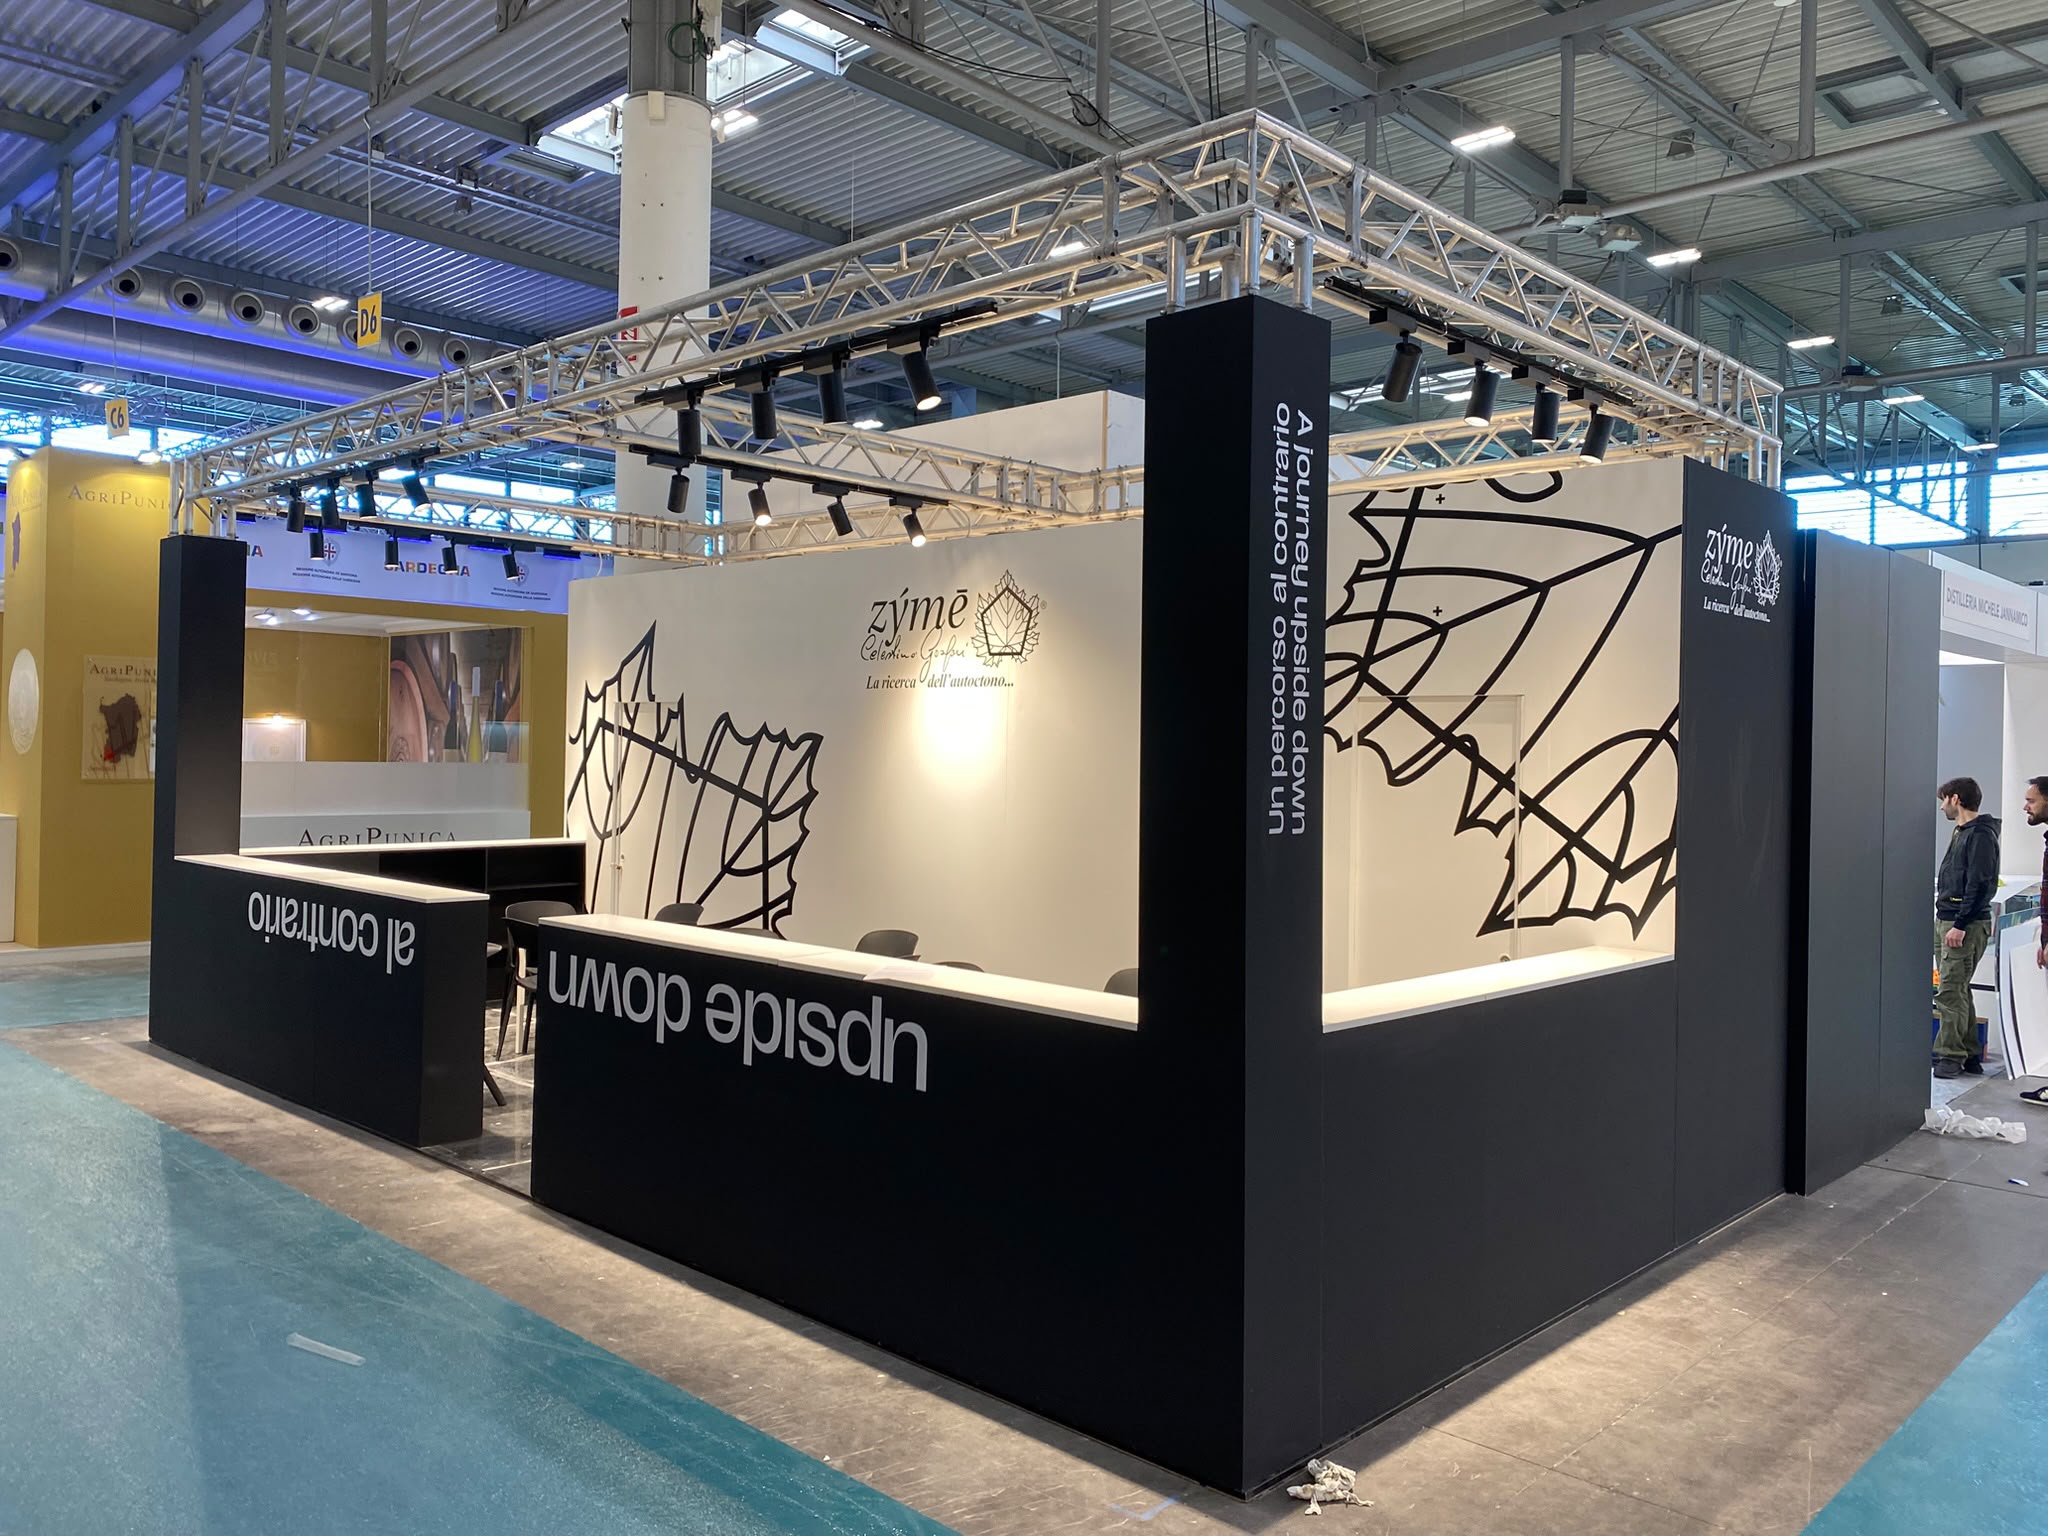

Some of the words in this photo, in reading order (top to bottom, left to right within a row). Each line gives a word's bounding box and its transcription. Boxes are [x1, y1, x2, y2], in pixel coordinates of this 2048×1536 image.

[360, 304, 377, 337] D6
[110, 406, 125, 429] C6
[1297, 409, 1313, 436] A
[68, 484, 171, 511] AGRIPUNI
[1273, 402, 1290, 565] contrario
[1291, 443, 1314, 587] journey
[867, 587, 969, 647] zýmē
[1270, 572, 1287, 604] al
[1946, 587, 1978, 610] DISTILLERIA
[1979, 597, 2000, 618] MICHELE
[866, 675, 879, 689] La
[881, 675, 916, 689] ricerca
[1291, 595, 1310, 721] upside
[1271, 615, 1288, 777] percorso
[1268, 786, 1285, 835] Un
[1292, 730, 1309, 835] down
[248, 891, 379, 958] contrario
[386, 918, 416, 975] al
[548, 950, 692, 1045] down
[705, 983, 929, 1093] upside
